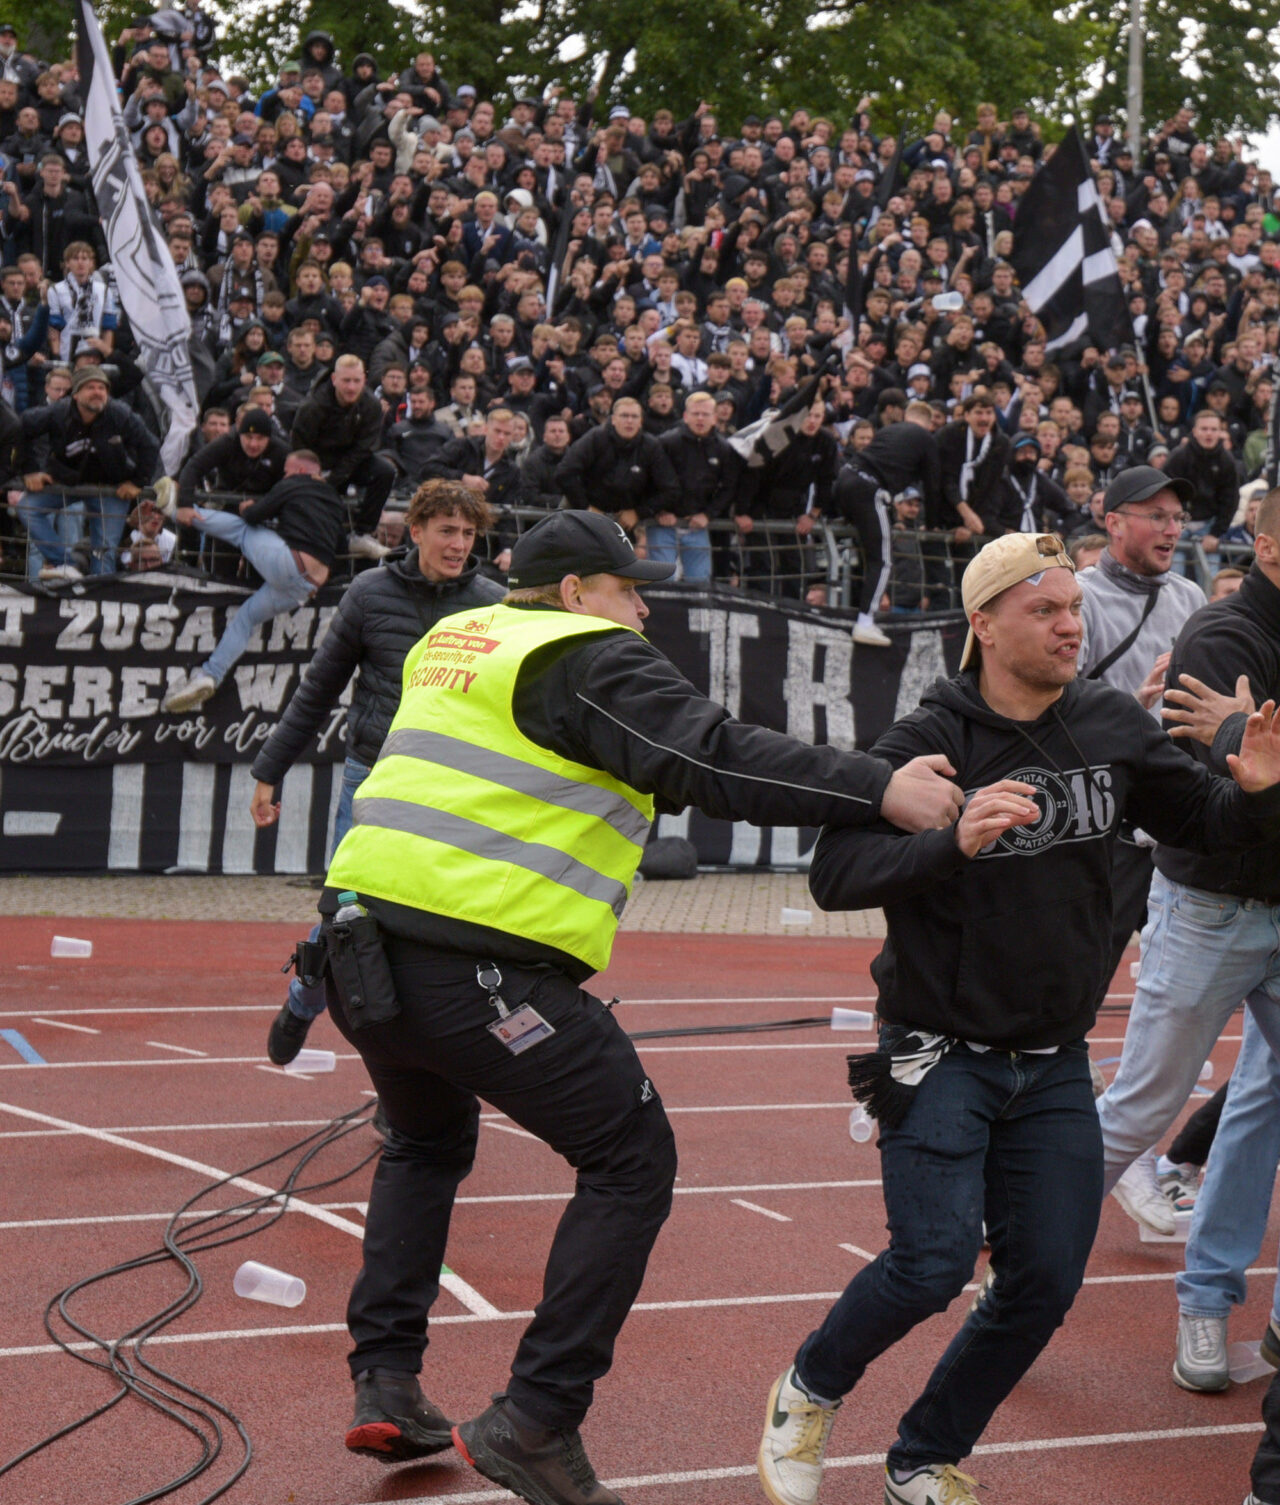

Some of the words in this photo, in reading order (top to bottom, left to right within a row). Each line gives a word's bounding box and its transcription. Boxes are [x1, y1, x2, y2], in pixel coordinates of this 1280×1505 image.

[155, 716, 215, 749] vor
[224, 711, 279, 752] de
[1056, 800, 1067, 809] 22
[1071, 769, 1116, 836] 46
[1013, 831, 1055, 850] SPATZEN
